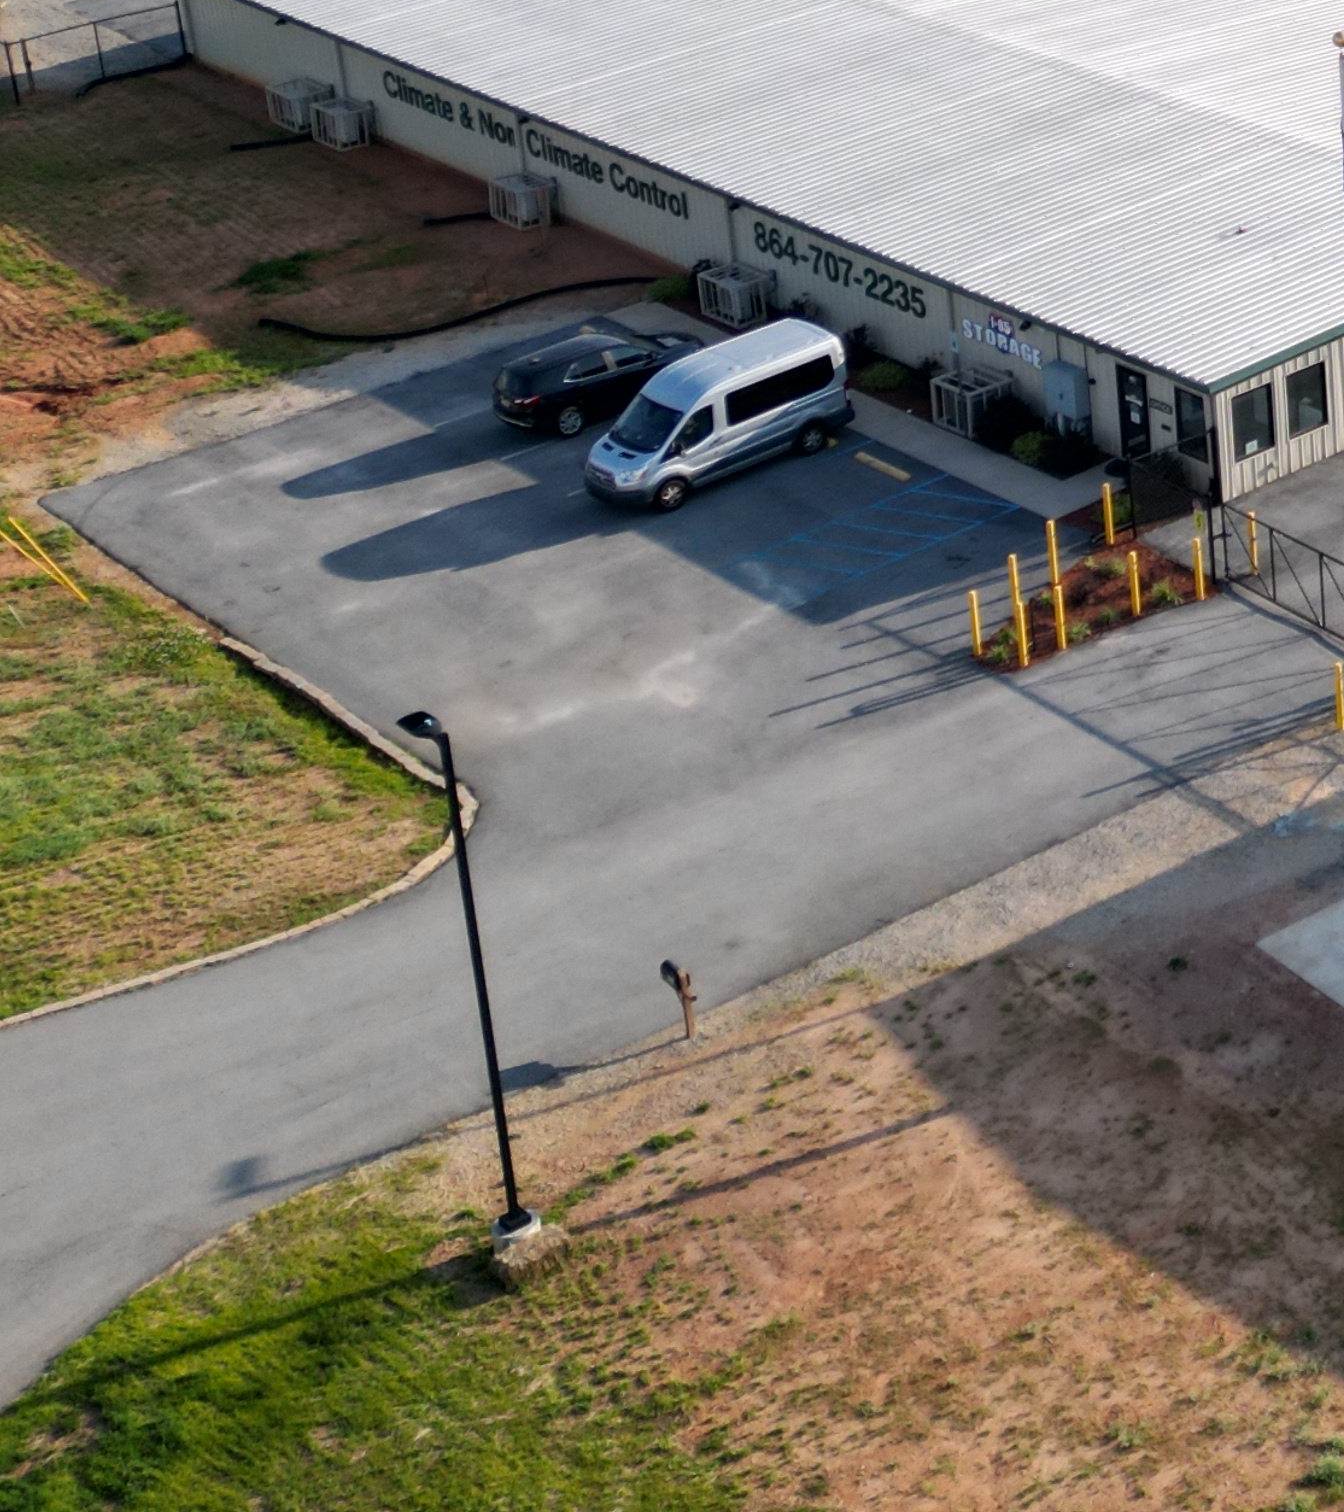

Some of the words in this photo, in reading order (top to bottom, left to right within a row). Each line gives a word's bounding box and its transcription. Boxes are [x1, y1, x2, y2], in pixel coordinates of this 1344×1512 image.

[383, 70, 453, 122] Climate
[459, 101, 475, 132] &
[526, 128, 604, 184] Climate
[609, 163, 688, 220] Control
[754, 221, 926, 319] 864-707-2235
[962, 318, 1041, 370] STORAGE
